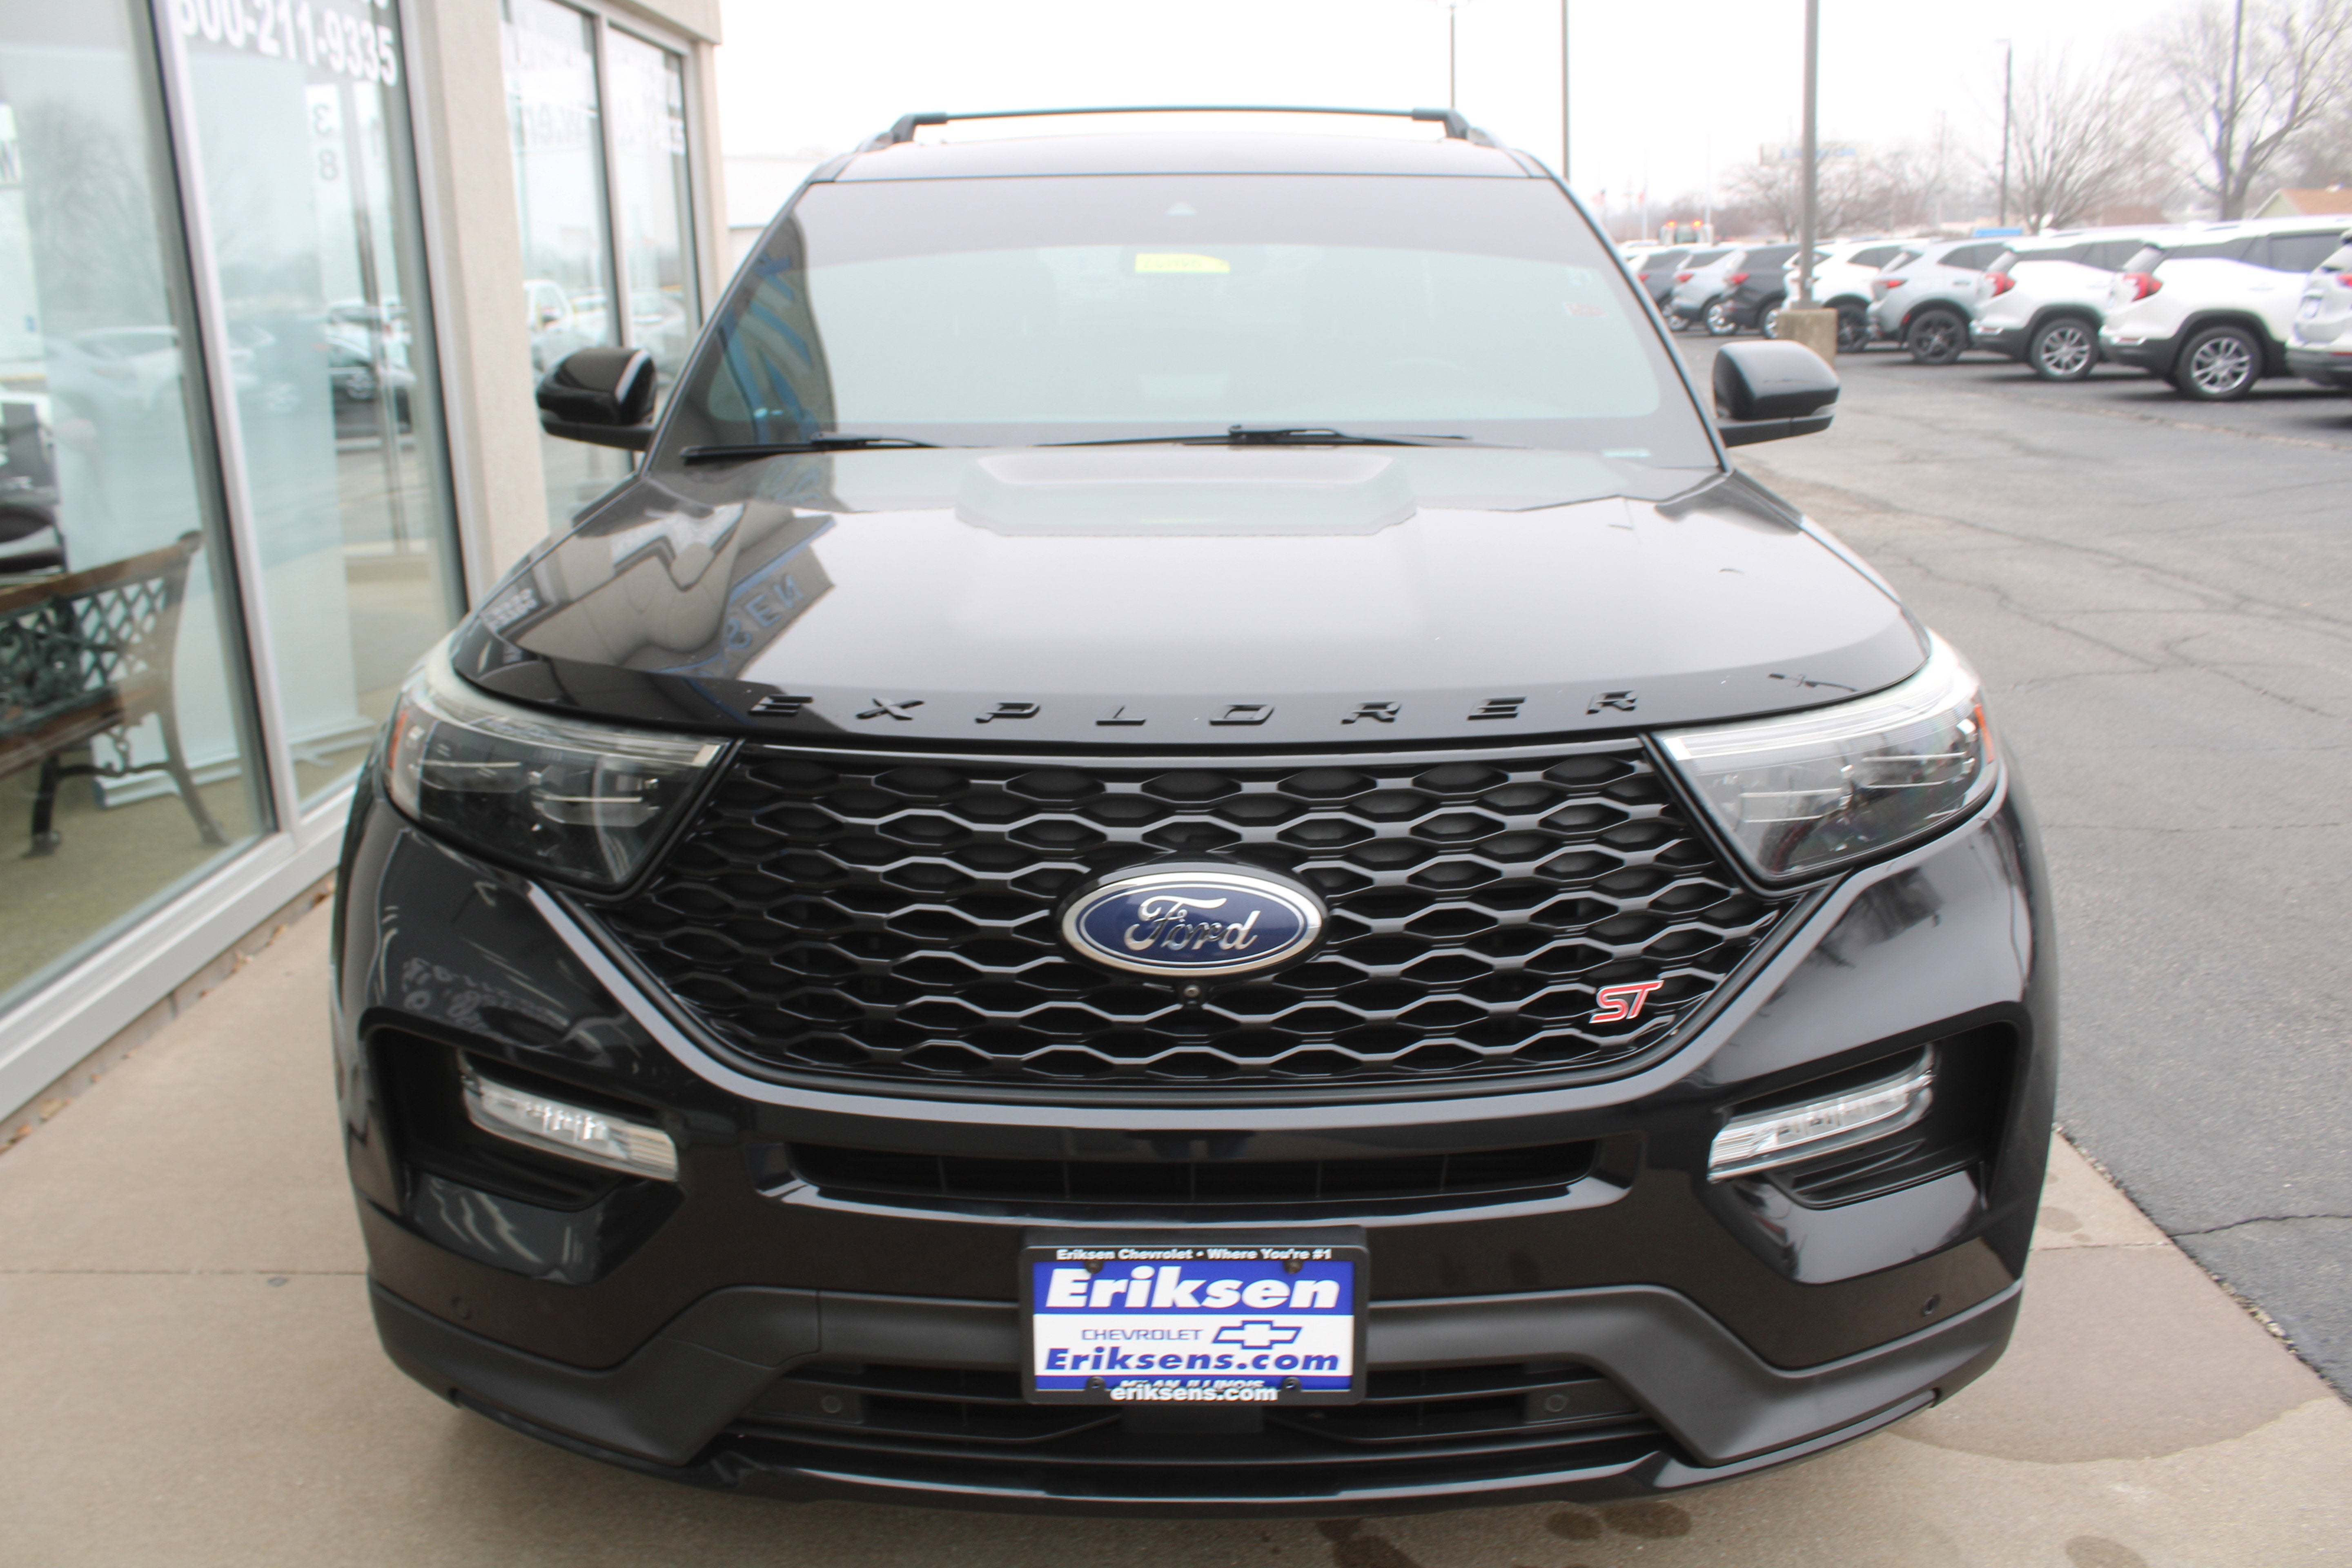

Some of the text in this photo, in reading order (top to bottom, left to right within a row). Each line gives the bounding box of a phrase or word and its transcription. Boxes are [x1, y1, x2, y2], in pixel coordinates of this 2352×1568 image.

[748, 690, 1639, 726] EXPLORER
[1124, 895, 1261, 951] Ford
[1589, 980, 1664, 1024] ST
[1056, 1248, 1332, 1261] Eriksen Chevrolet Where You're #1
[1045, 1265, 1341, 1309] Eriksen
[1081, 1329, 1203, 1341] CHEVROLET
[1045, 1346, 1339, 1371] Eriksens.com
[1110, 1383, 1278, 1401] eriksens.com
